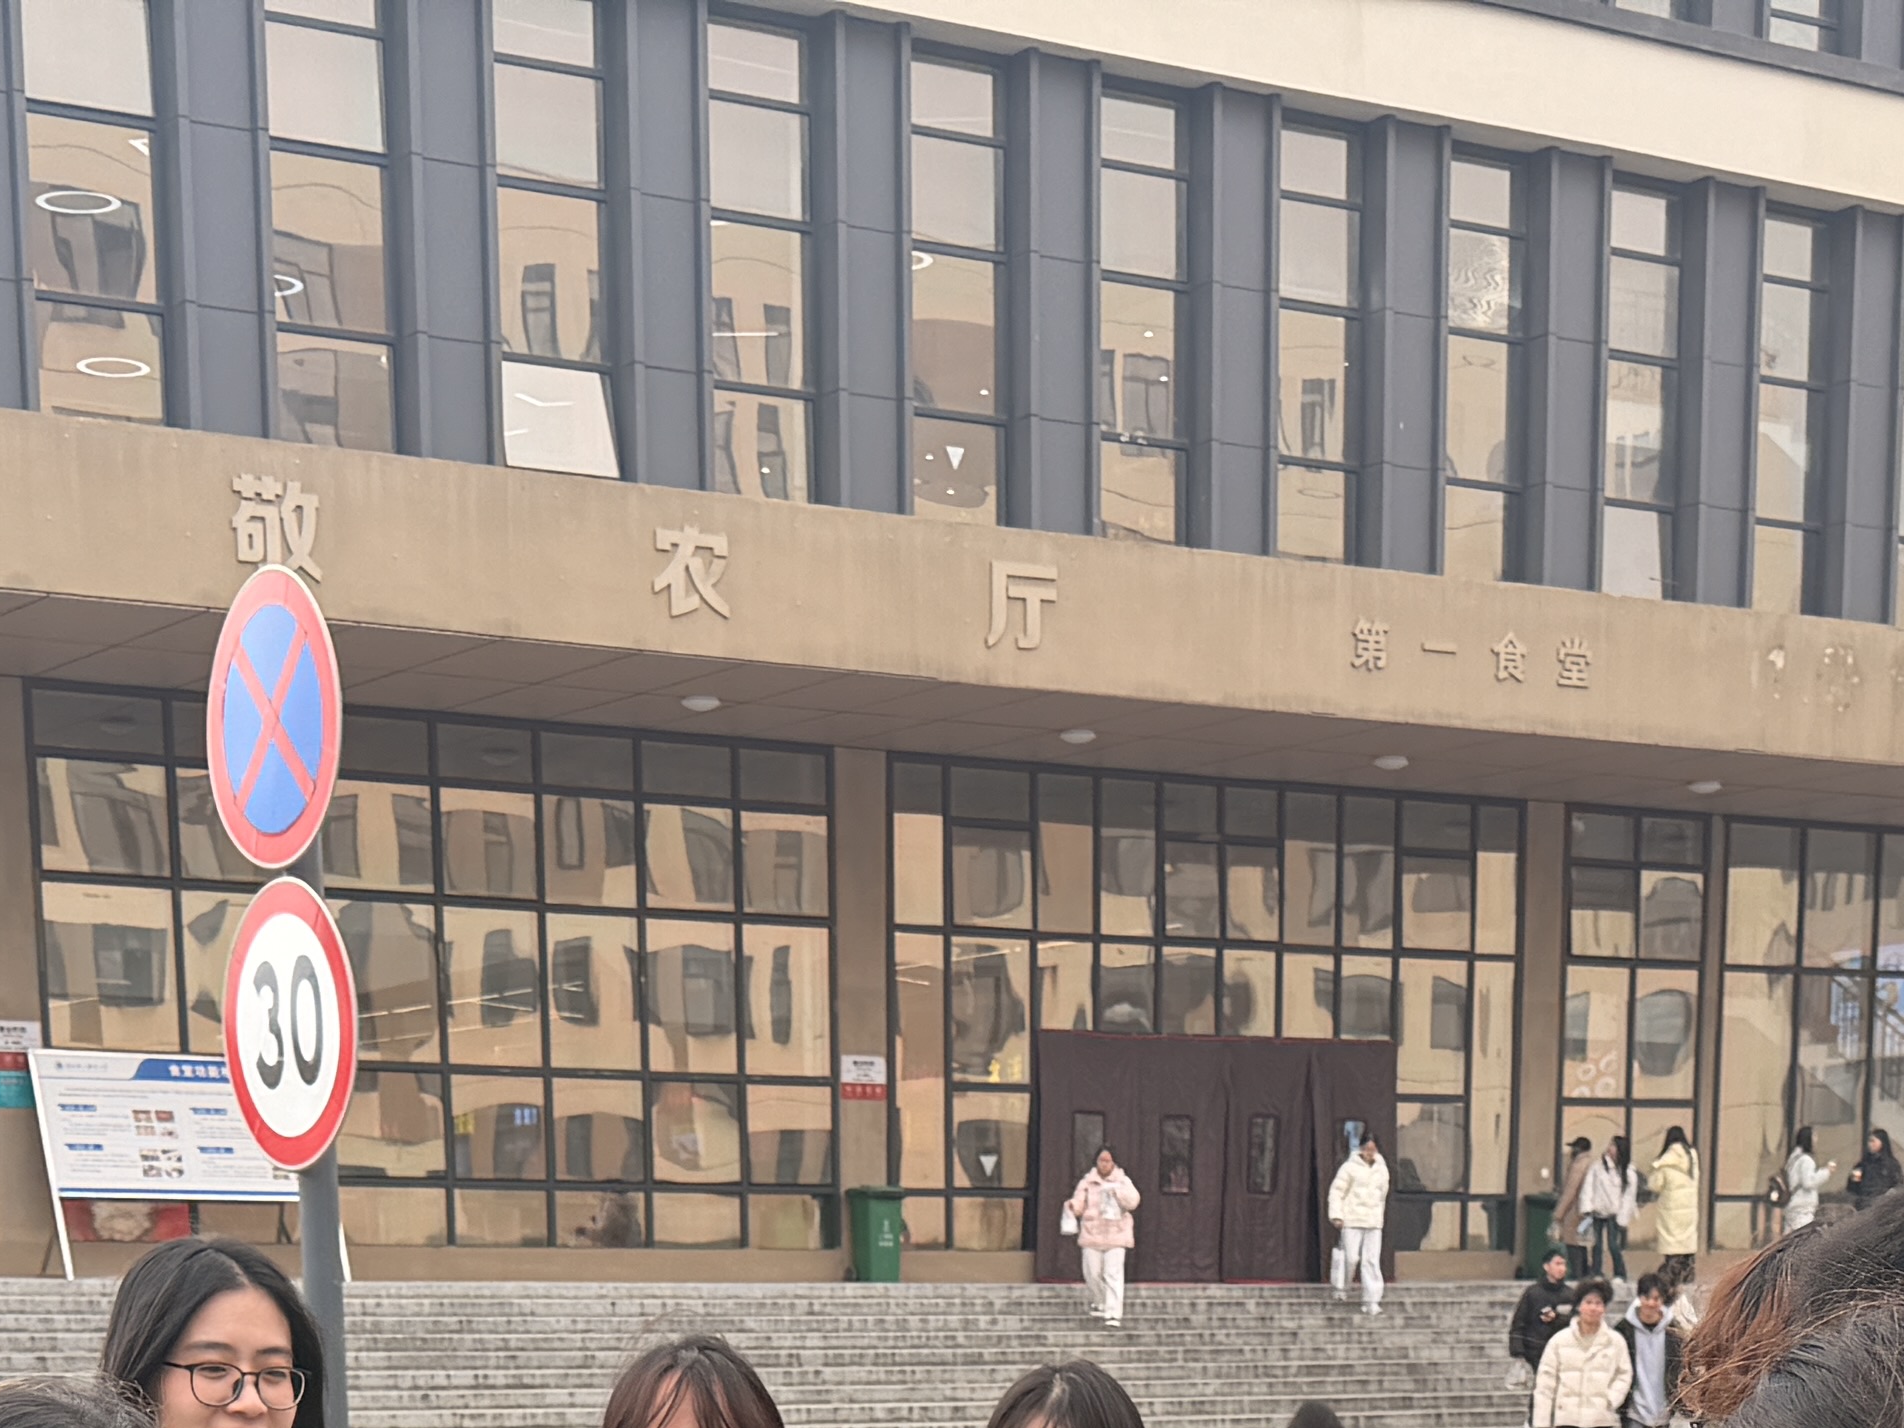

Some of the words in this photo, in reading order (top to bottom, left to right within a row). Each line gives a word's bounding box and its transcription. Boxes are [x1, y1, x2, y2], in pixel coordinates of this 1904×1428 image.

[230, 473, 1059, 651] 敬农厅
[1350, 616, 1593, 690] 第一食堂
[251, 953, 321, 1091] 30
